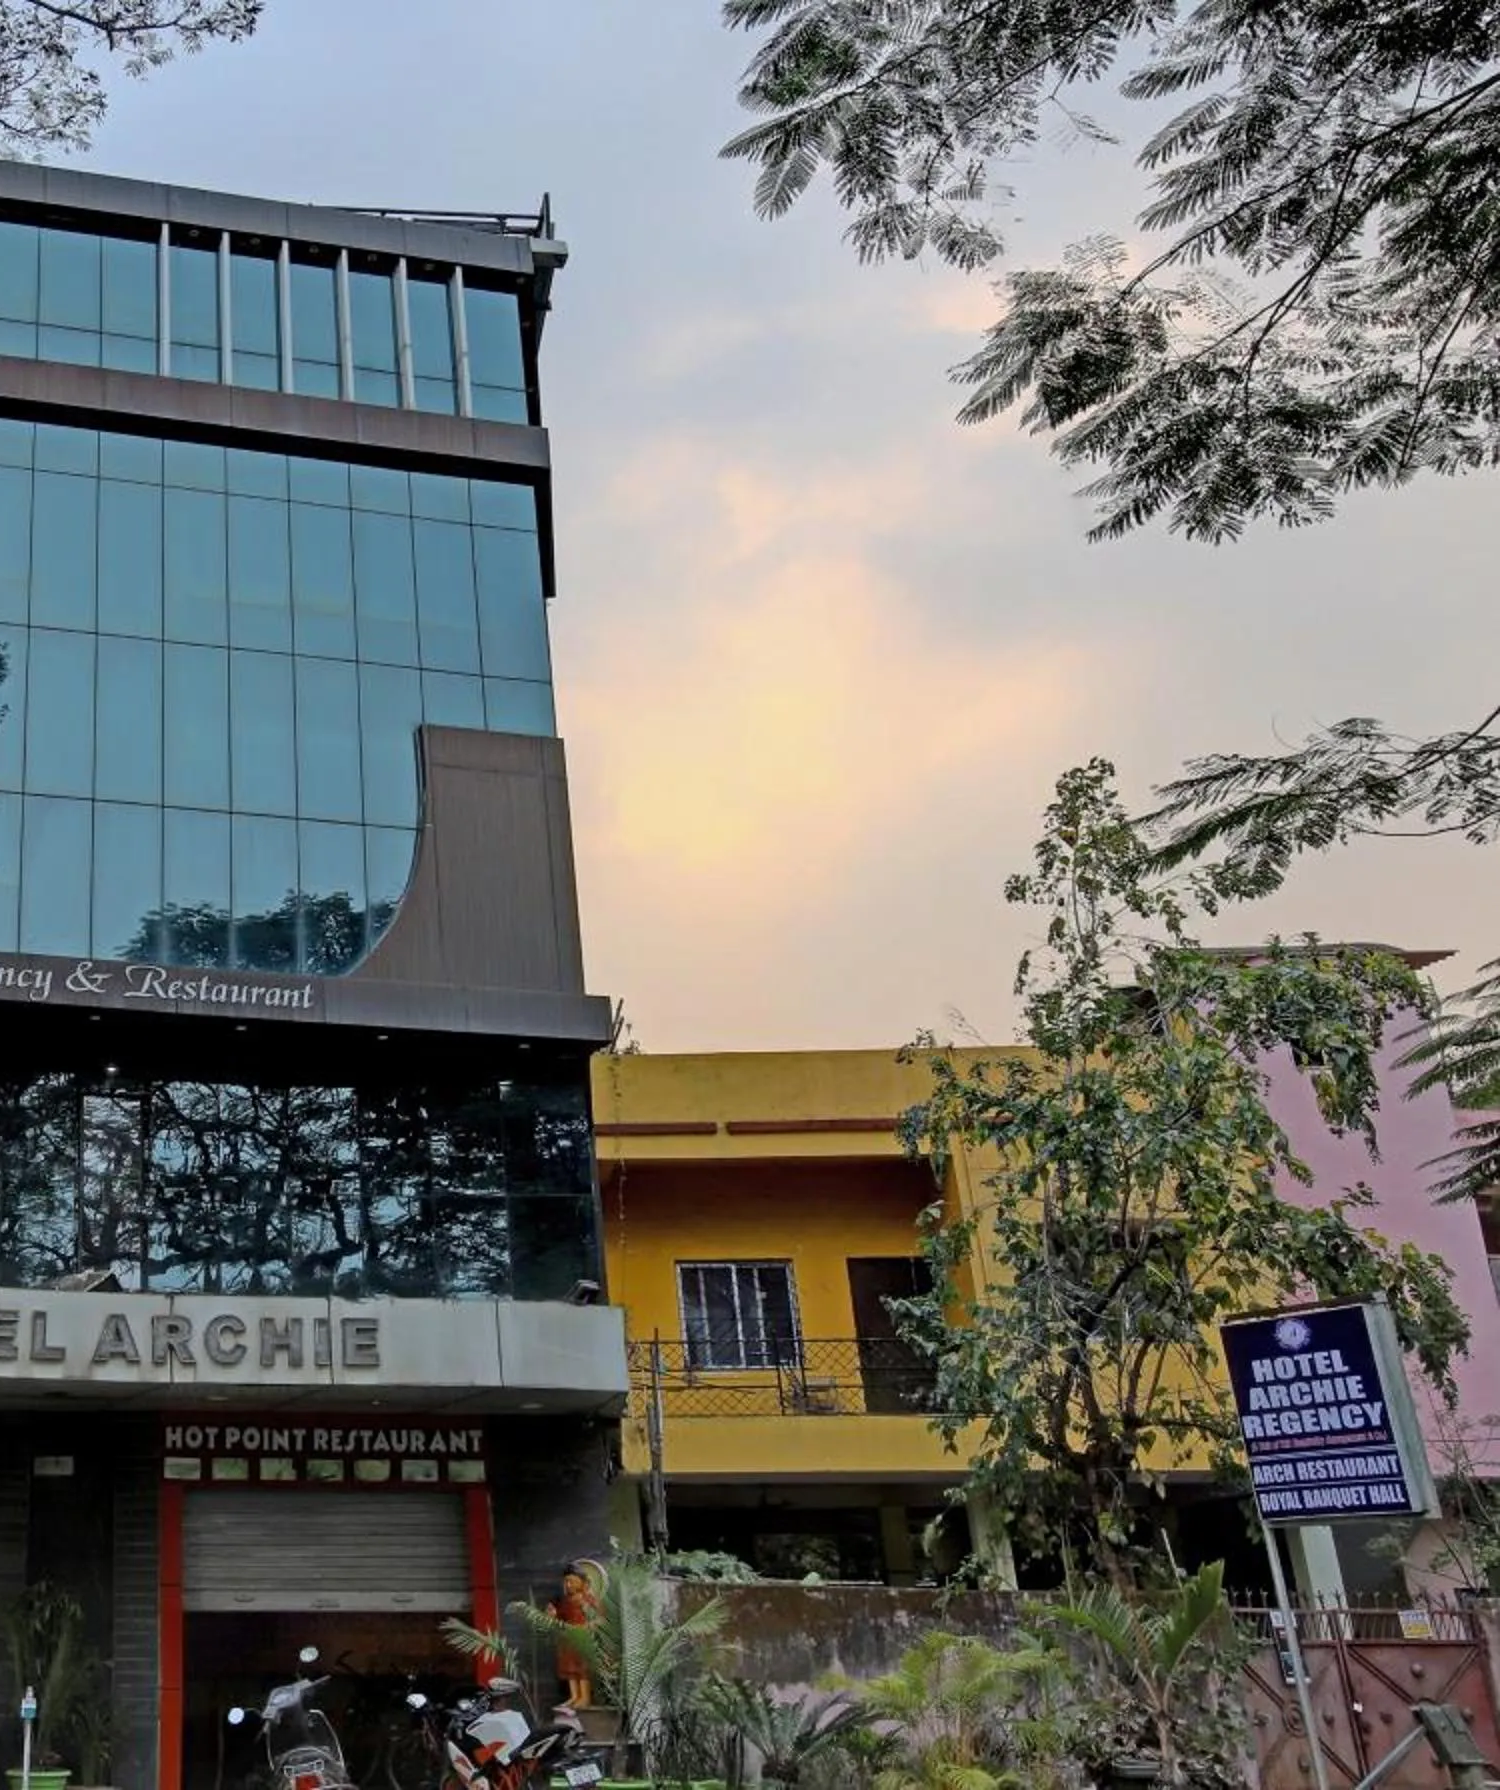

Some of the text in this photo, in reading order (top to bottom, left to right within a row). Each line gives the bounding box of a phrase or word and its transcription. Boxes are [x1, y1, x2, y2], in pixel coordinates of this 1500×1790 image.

[65, 960, 114, 994] &
[123, 964, 313, 1009] Restaurant
[93, 1312, 381, 1368] ARCHIE
[1251, 1349, 1349, 1383] HOTEL
[1248, 1375, 1367, 1411] ARCHIE
[1242, 1401, 1383, 1439] REGENCY
[165, 1426, 484, 1454] HOT POINT RESTAURANT
[1253, 1455, 1399, 1485] ARCH RESTAURANT
[1259, 1484, 1406, 1512] ROYAL BANQUET HALL
